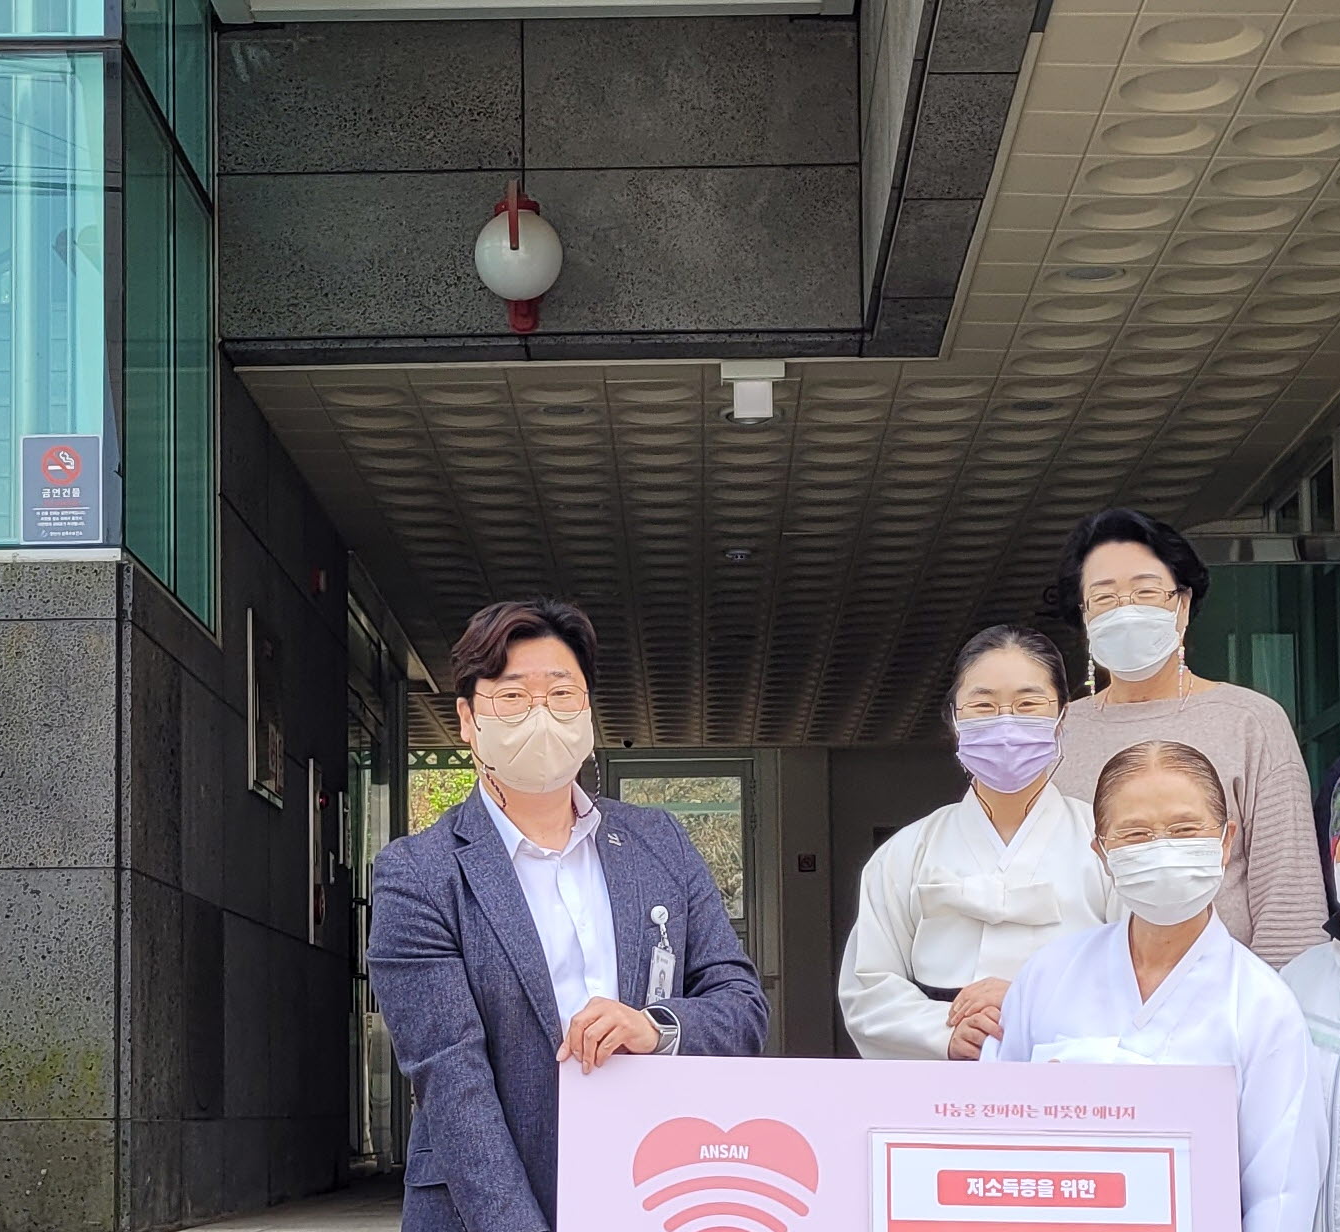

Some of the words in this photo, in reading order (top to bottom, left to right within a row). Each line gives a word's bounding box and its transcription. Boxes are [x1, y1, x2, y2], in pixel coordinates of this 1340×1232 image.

[934, 1102, 977, 1118] 나눔을
[981, 1103, 1039, 1119] 전파하는
[1043, 1105, 1088, 1120] 따뜻한
[1092, 1105, 1136, 1120] 에너지
[700, 1144, 749, 1160] ANSAN
[966, 1177, 1055, 1199] 저소득층을
[1060, 1179, 1096, 1199] 위한
